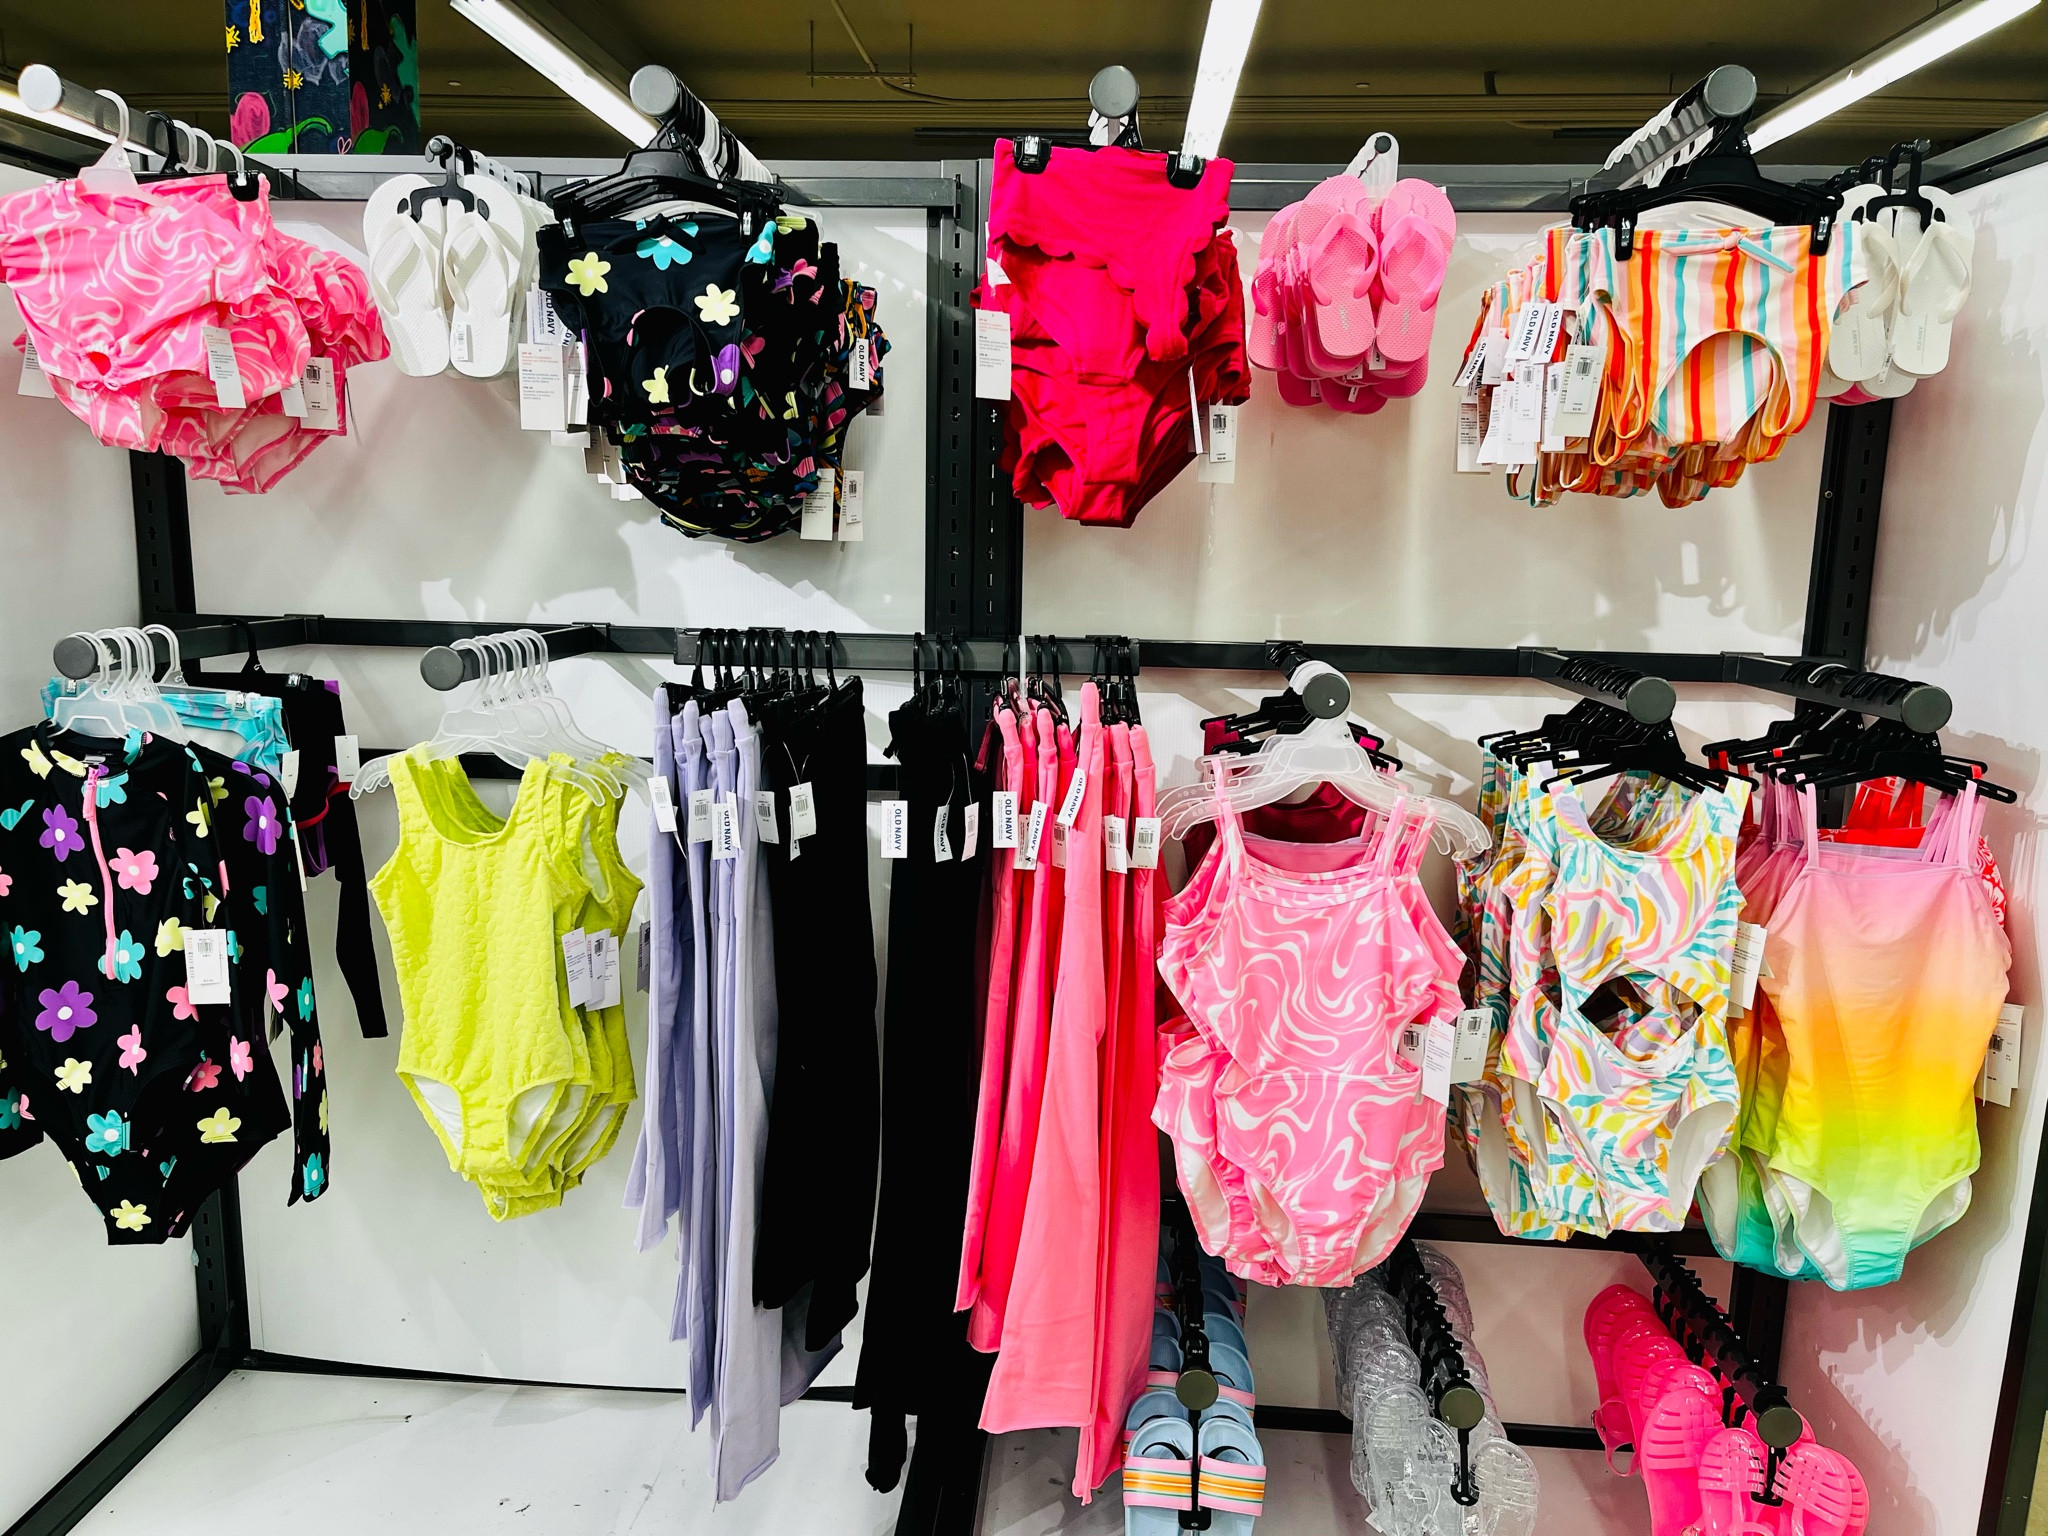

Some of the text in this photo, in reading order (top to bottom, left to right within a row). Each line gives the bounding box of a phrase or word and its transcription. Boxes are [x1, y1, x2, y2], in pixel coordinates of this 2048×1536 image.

[546, 310, 556, 336] NAVY
[1521, 310, 1539, 352] OLD NAVY
[1544, 310, 1560, 355] OLD NAVY
[1466, 342, 1487, 380] OLD NAVY
[1668, 730, 1675, 738] S
[1931, 739, 1938, 747] S
[1068, 777, 1084, 818] OLD NAVY
[894, 808, 902, 851] OLD NAVY
[1005, 817, 1013, 841] NAVY
[1031, 828, 1039, 851] NAVY
